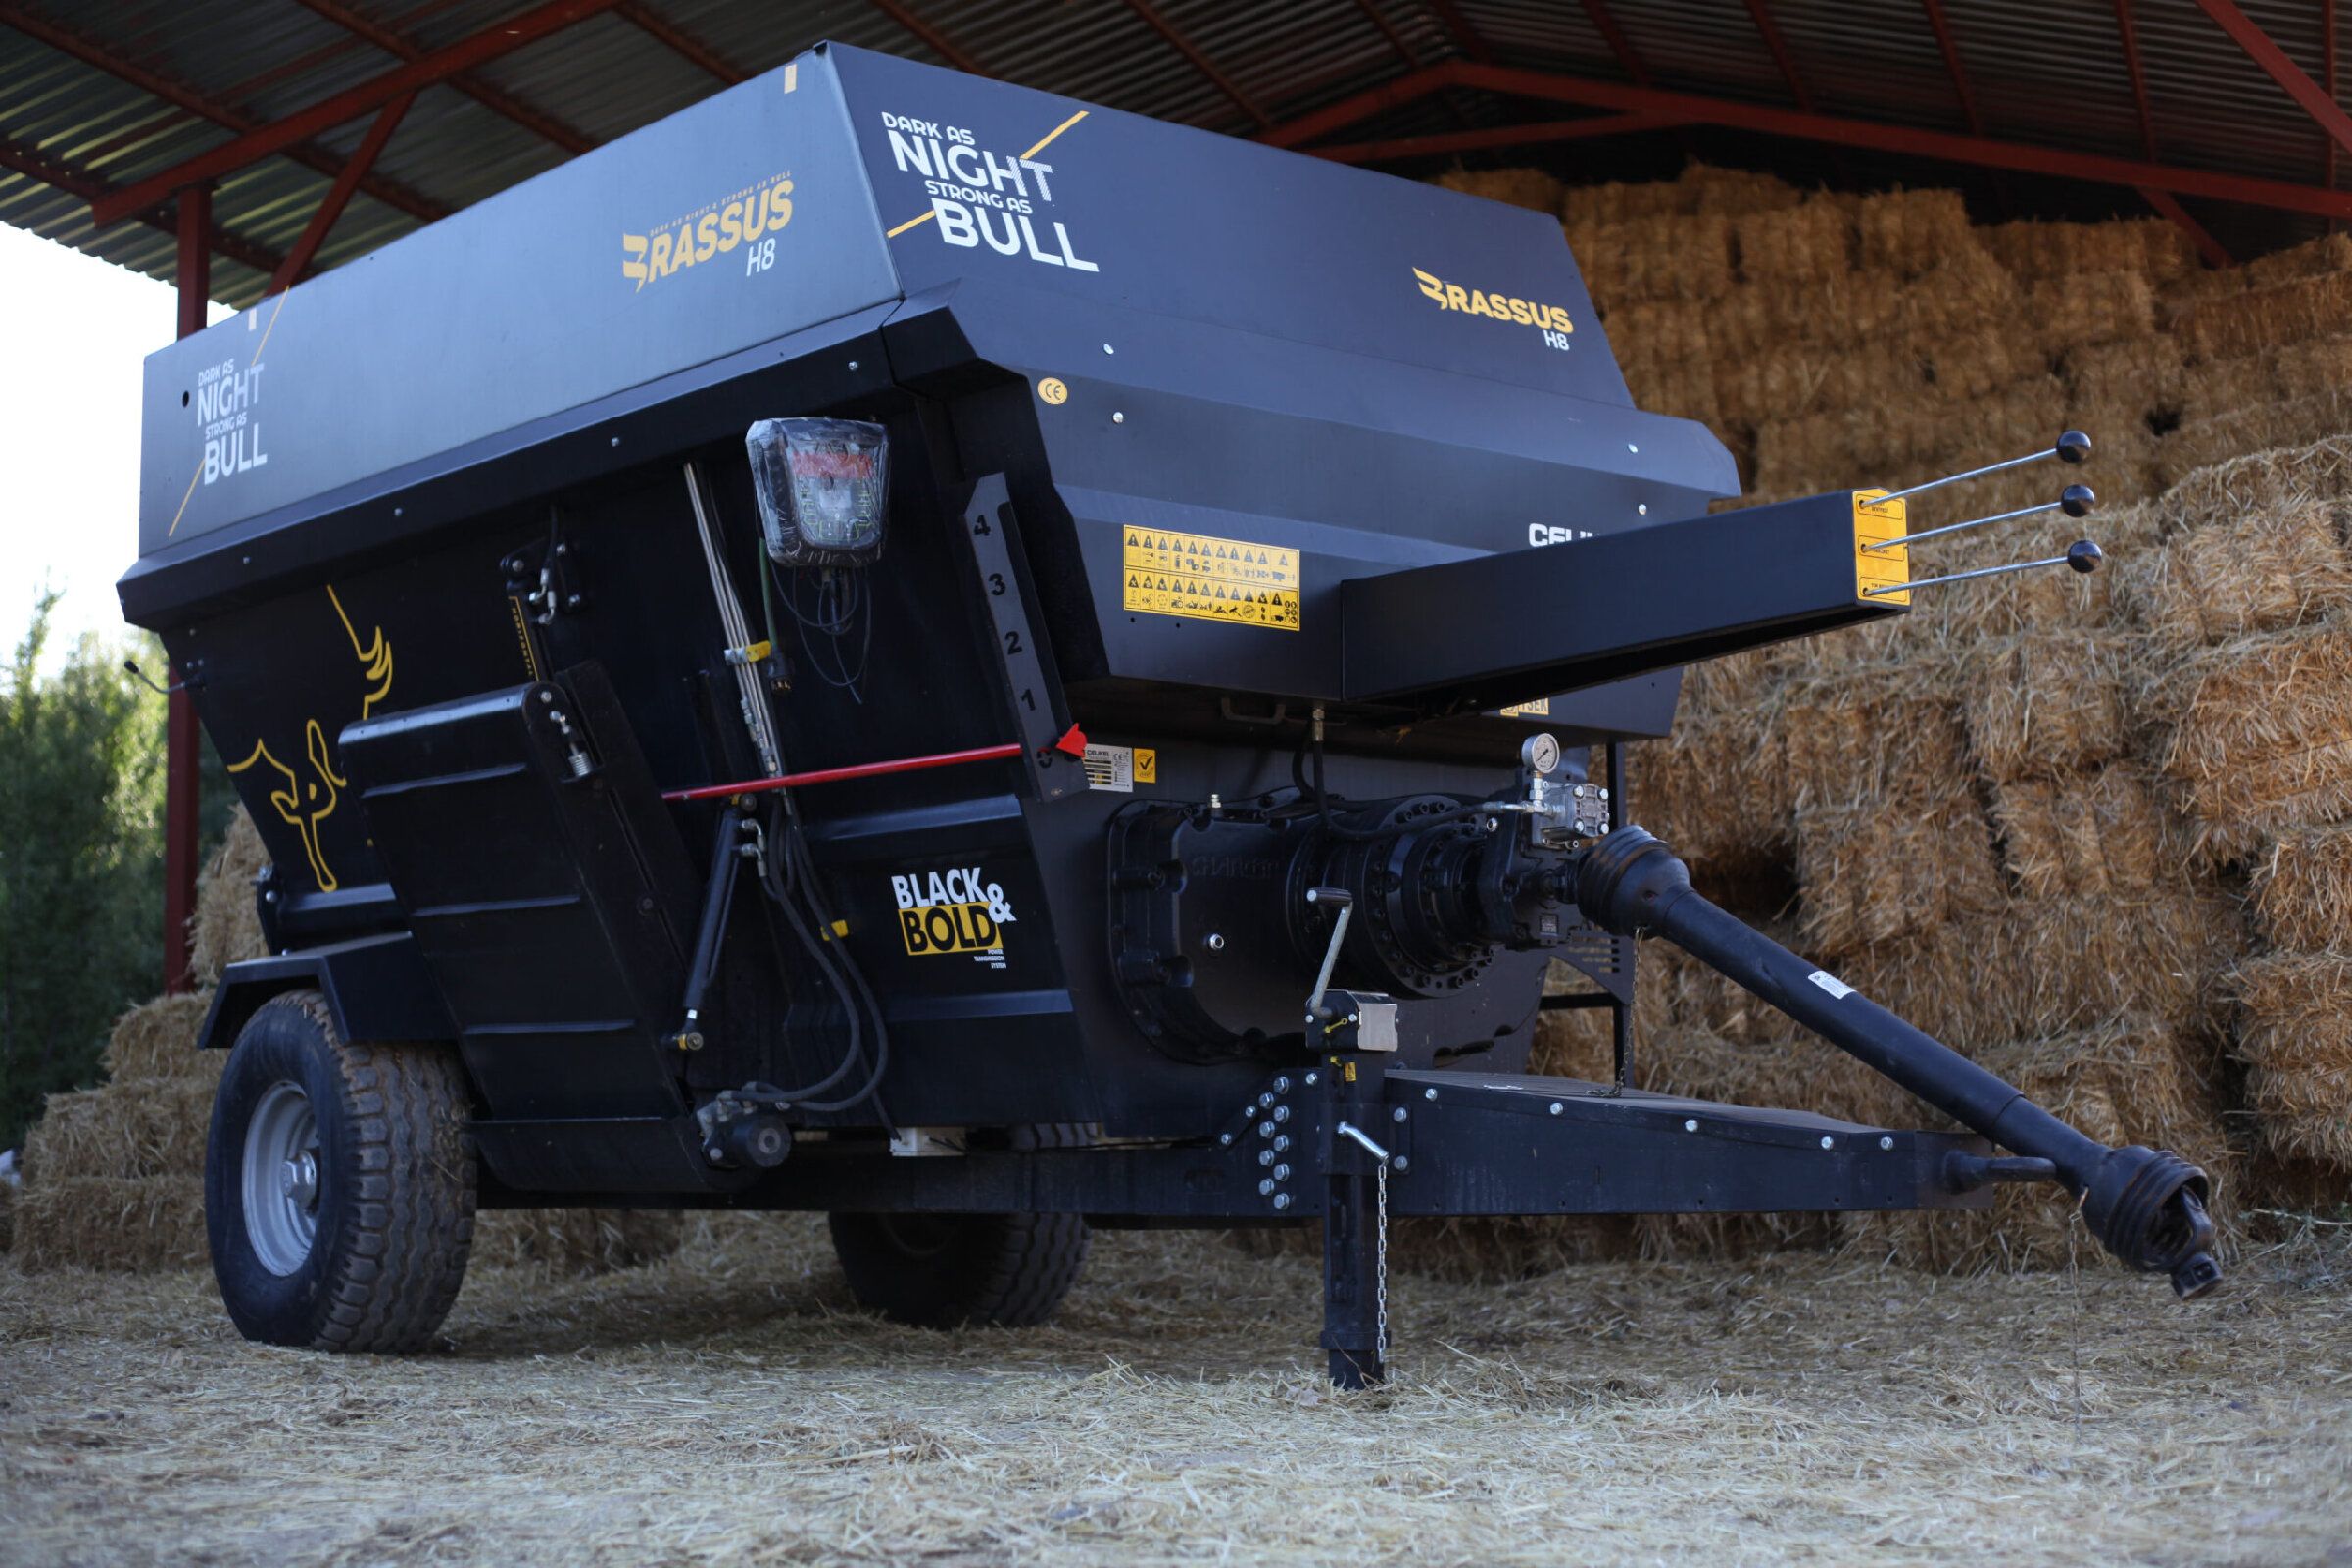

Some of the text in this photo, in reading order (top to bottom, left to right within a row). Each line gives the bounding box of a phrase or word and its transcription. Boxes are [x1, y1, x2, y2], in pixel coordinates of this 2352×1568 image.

[881, 111, 976, 146] DARK AS
[887, 130, 1054, 202] NIGHT
[924, 180, 1033, 215] STRONG AS
[931, 197, 1100, 273] BULL
[746, 237, 776, 277] H8
[1543, 329, 1570, 351] H8
[198, 358, 234, 387] DARK AS
[197, 362, 265, 426] NIGHT
[1045, 383, 1061, 400] CE
[205, 411, 247, 441] STRONG AS
[204, 422, 268, 486] BULL
[974, 515, 991, 536] 4
[989, 573, 1006, 595] 3
[1004, 631, 1022, 655] 2
[1021, 689, 1036, 710] 1
[891, 867, 1018, 924] BLACK &
[902, 905, 997, 951] BOLD
